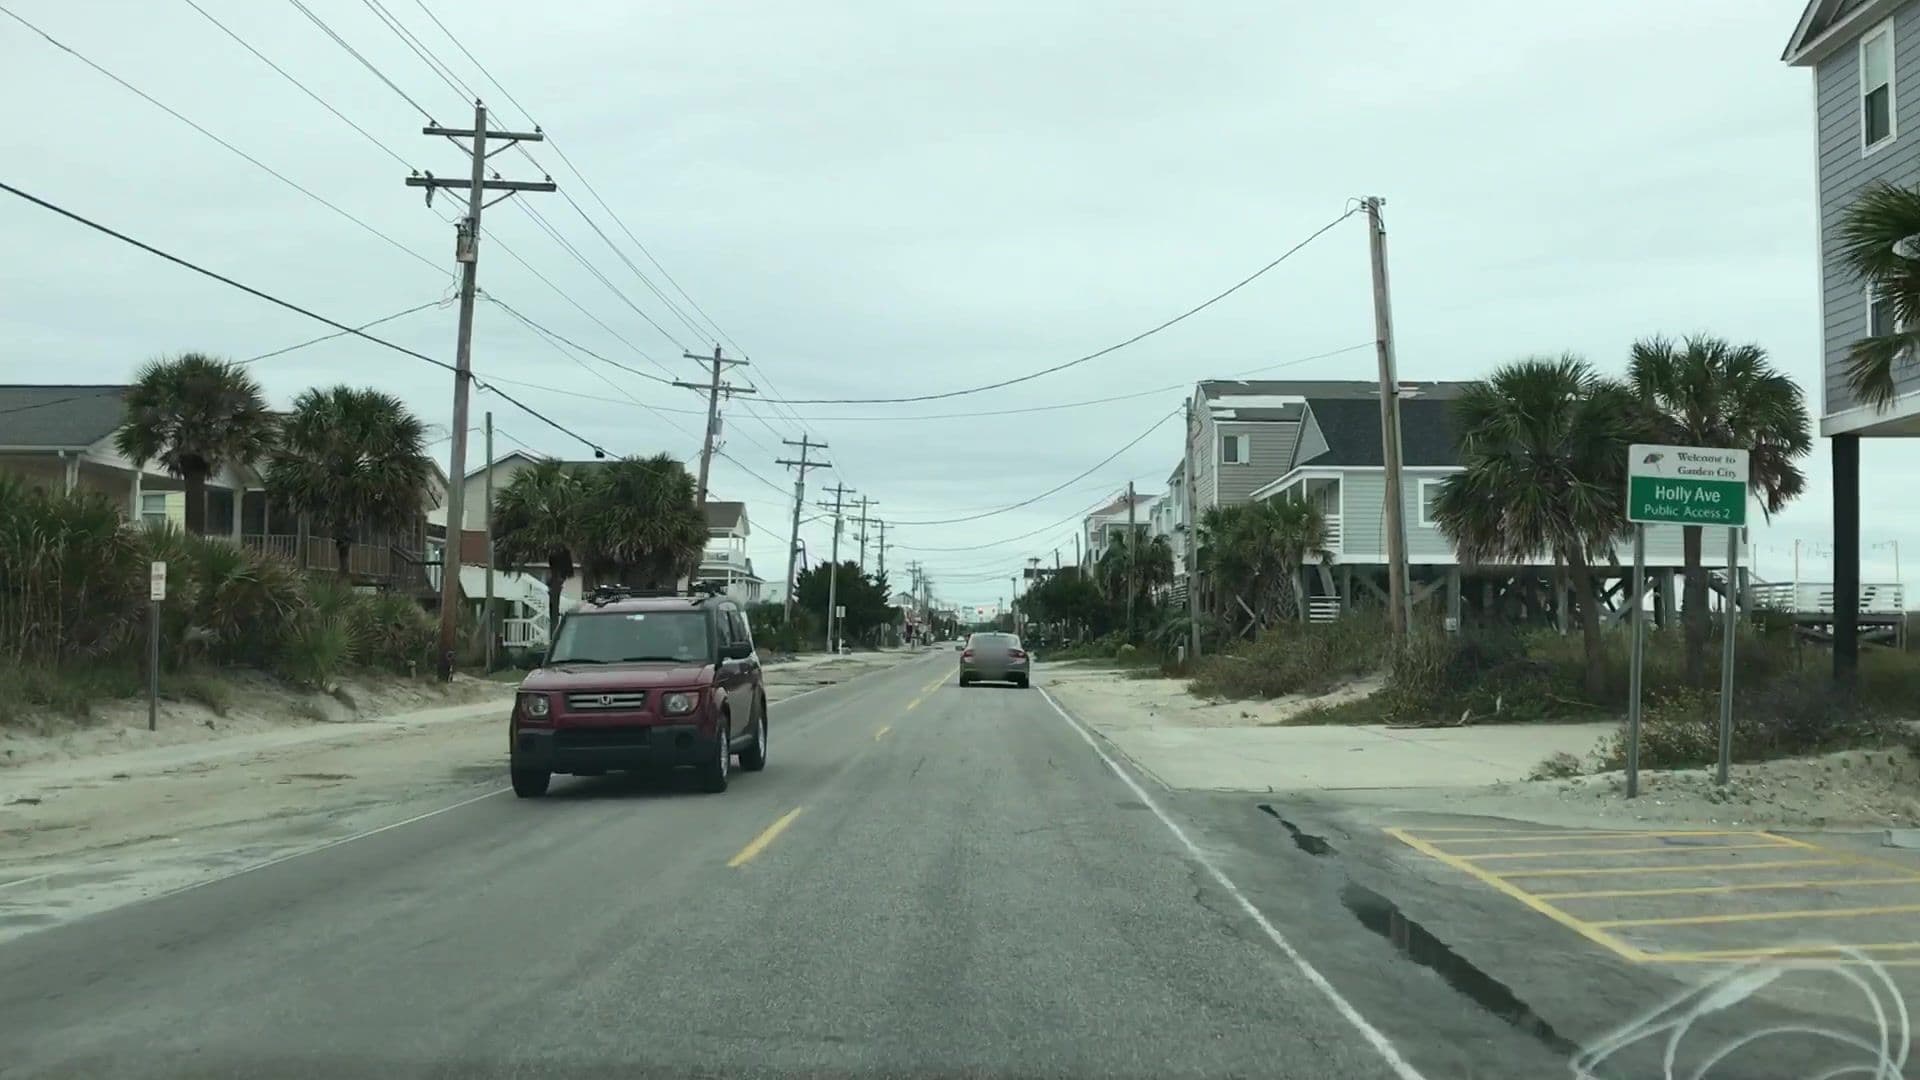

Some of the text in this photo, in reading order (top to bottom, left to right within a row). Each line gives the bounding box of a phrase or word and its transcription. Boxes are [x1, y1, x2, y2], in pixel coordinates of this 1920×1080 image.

[1677, 452, 1736, 464] Welcome to
[1677, 466, 1737, 479] Garden City
[1655, 486, 1721, 504] Holly Ave
[1644, 504, 1730, 519] Public Access 2
